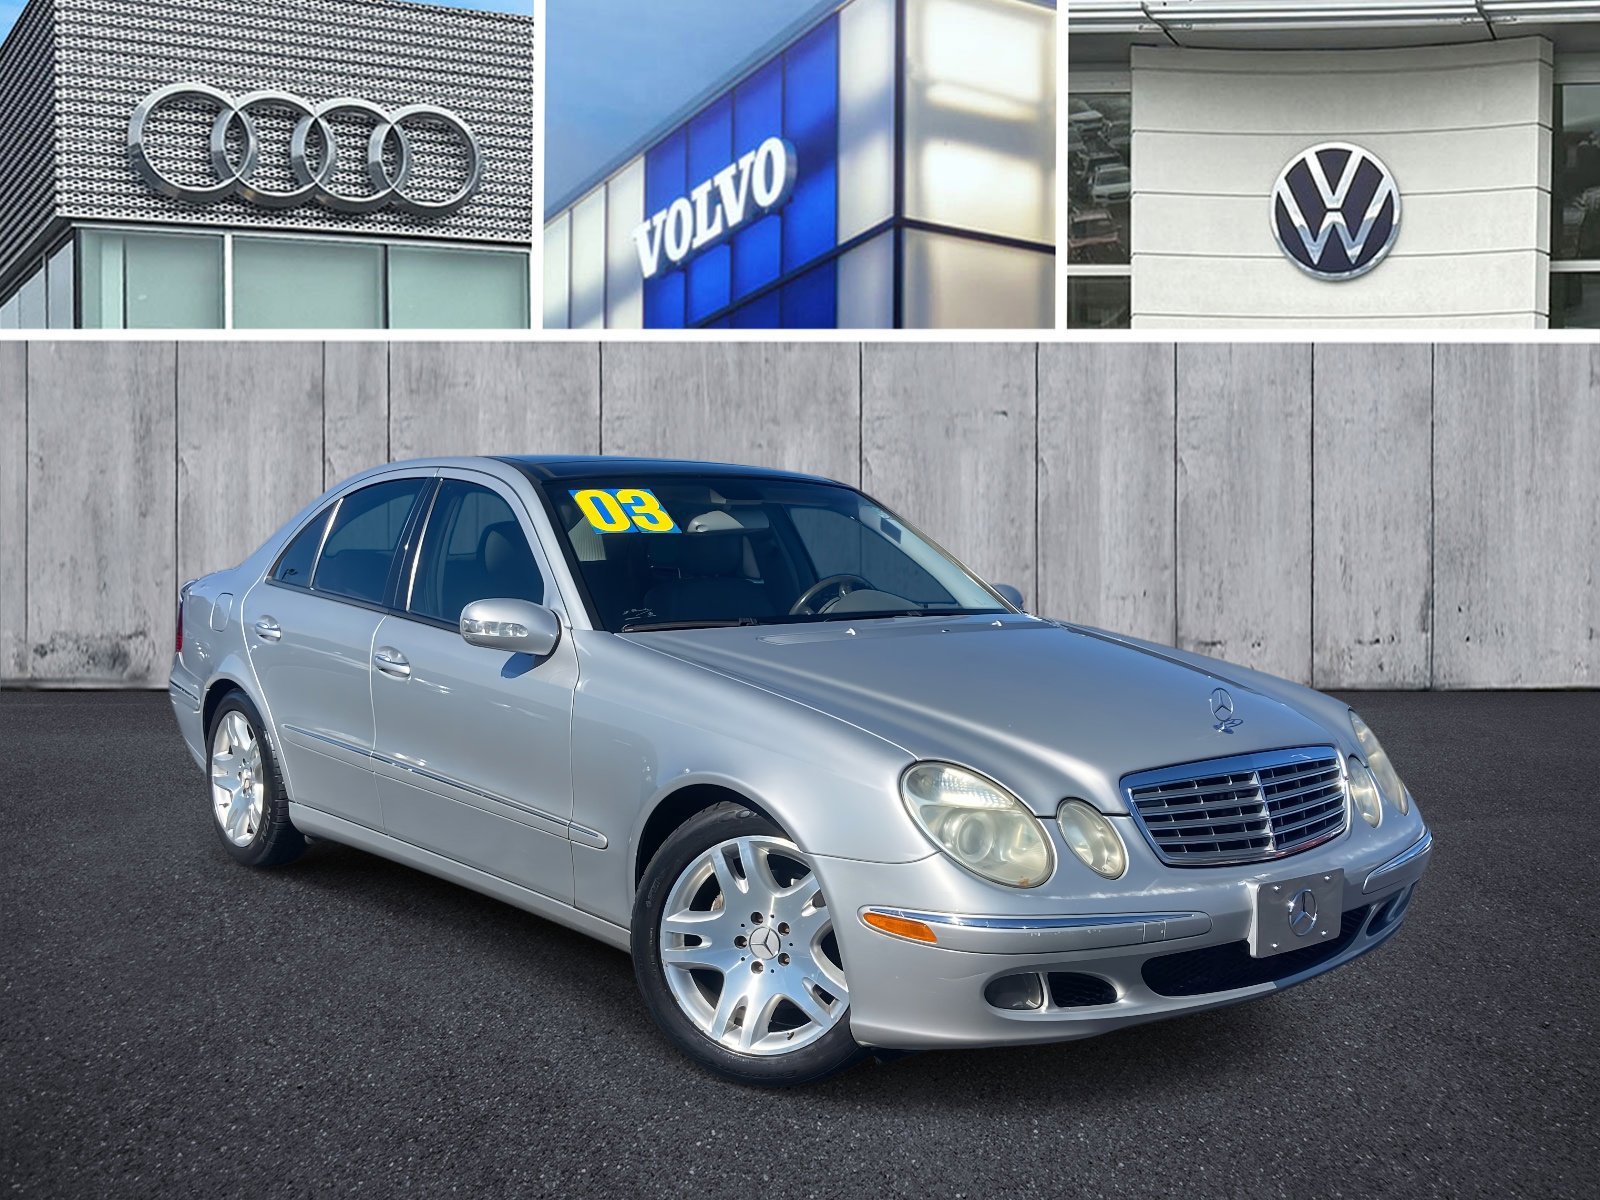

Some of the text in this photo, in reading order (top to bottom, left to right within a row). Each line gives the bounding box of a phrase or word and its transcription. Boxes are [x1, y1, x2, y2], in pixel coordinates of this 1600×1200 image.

[632, 136, 787, 279] VOLVO
[1274, 146, 1395, 267] VW
[574, 489, 674, 532] 03
